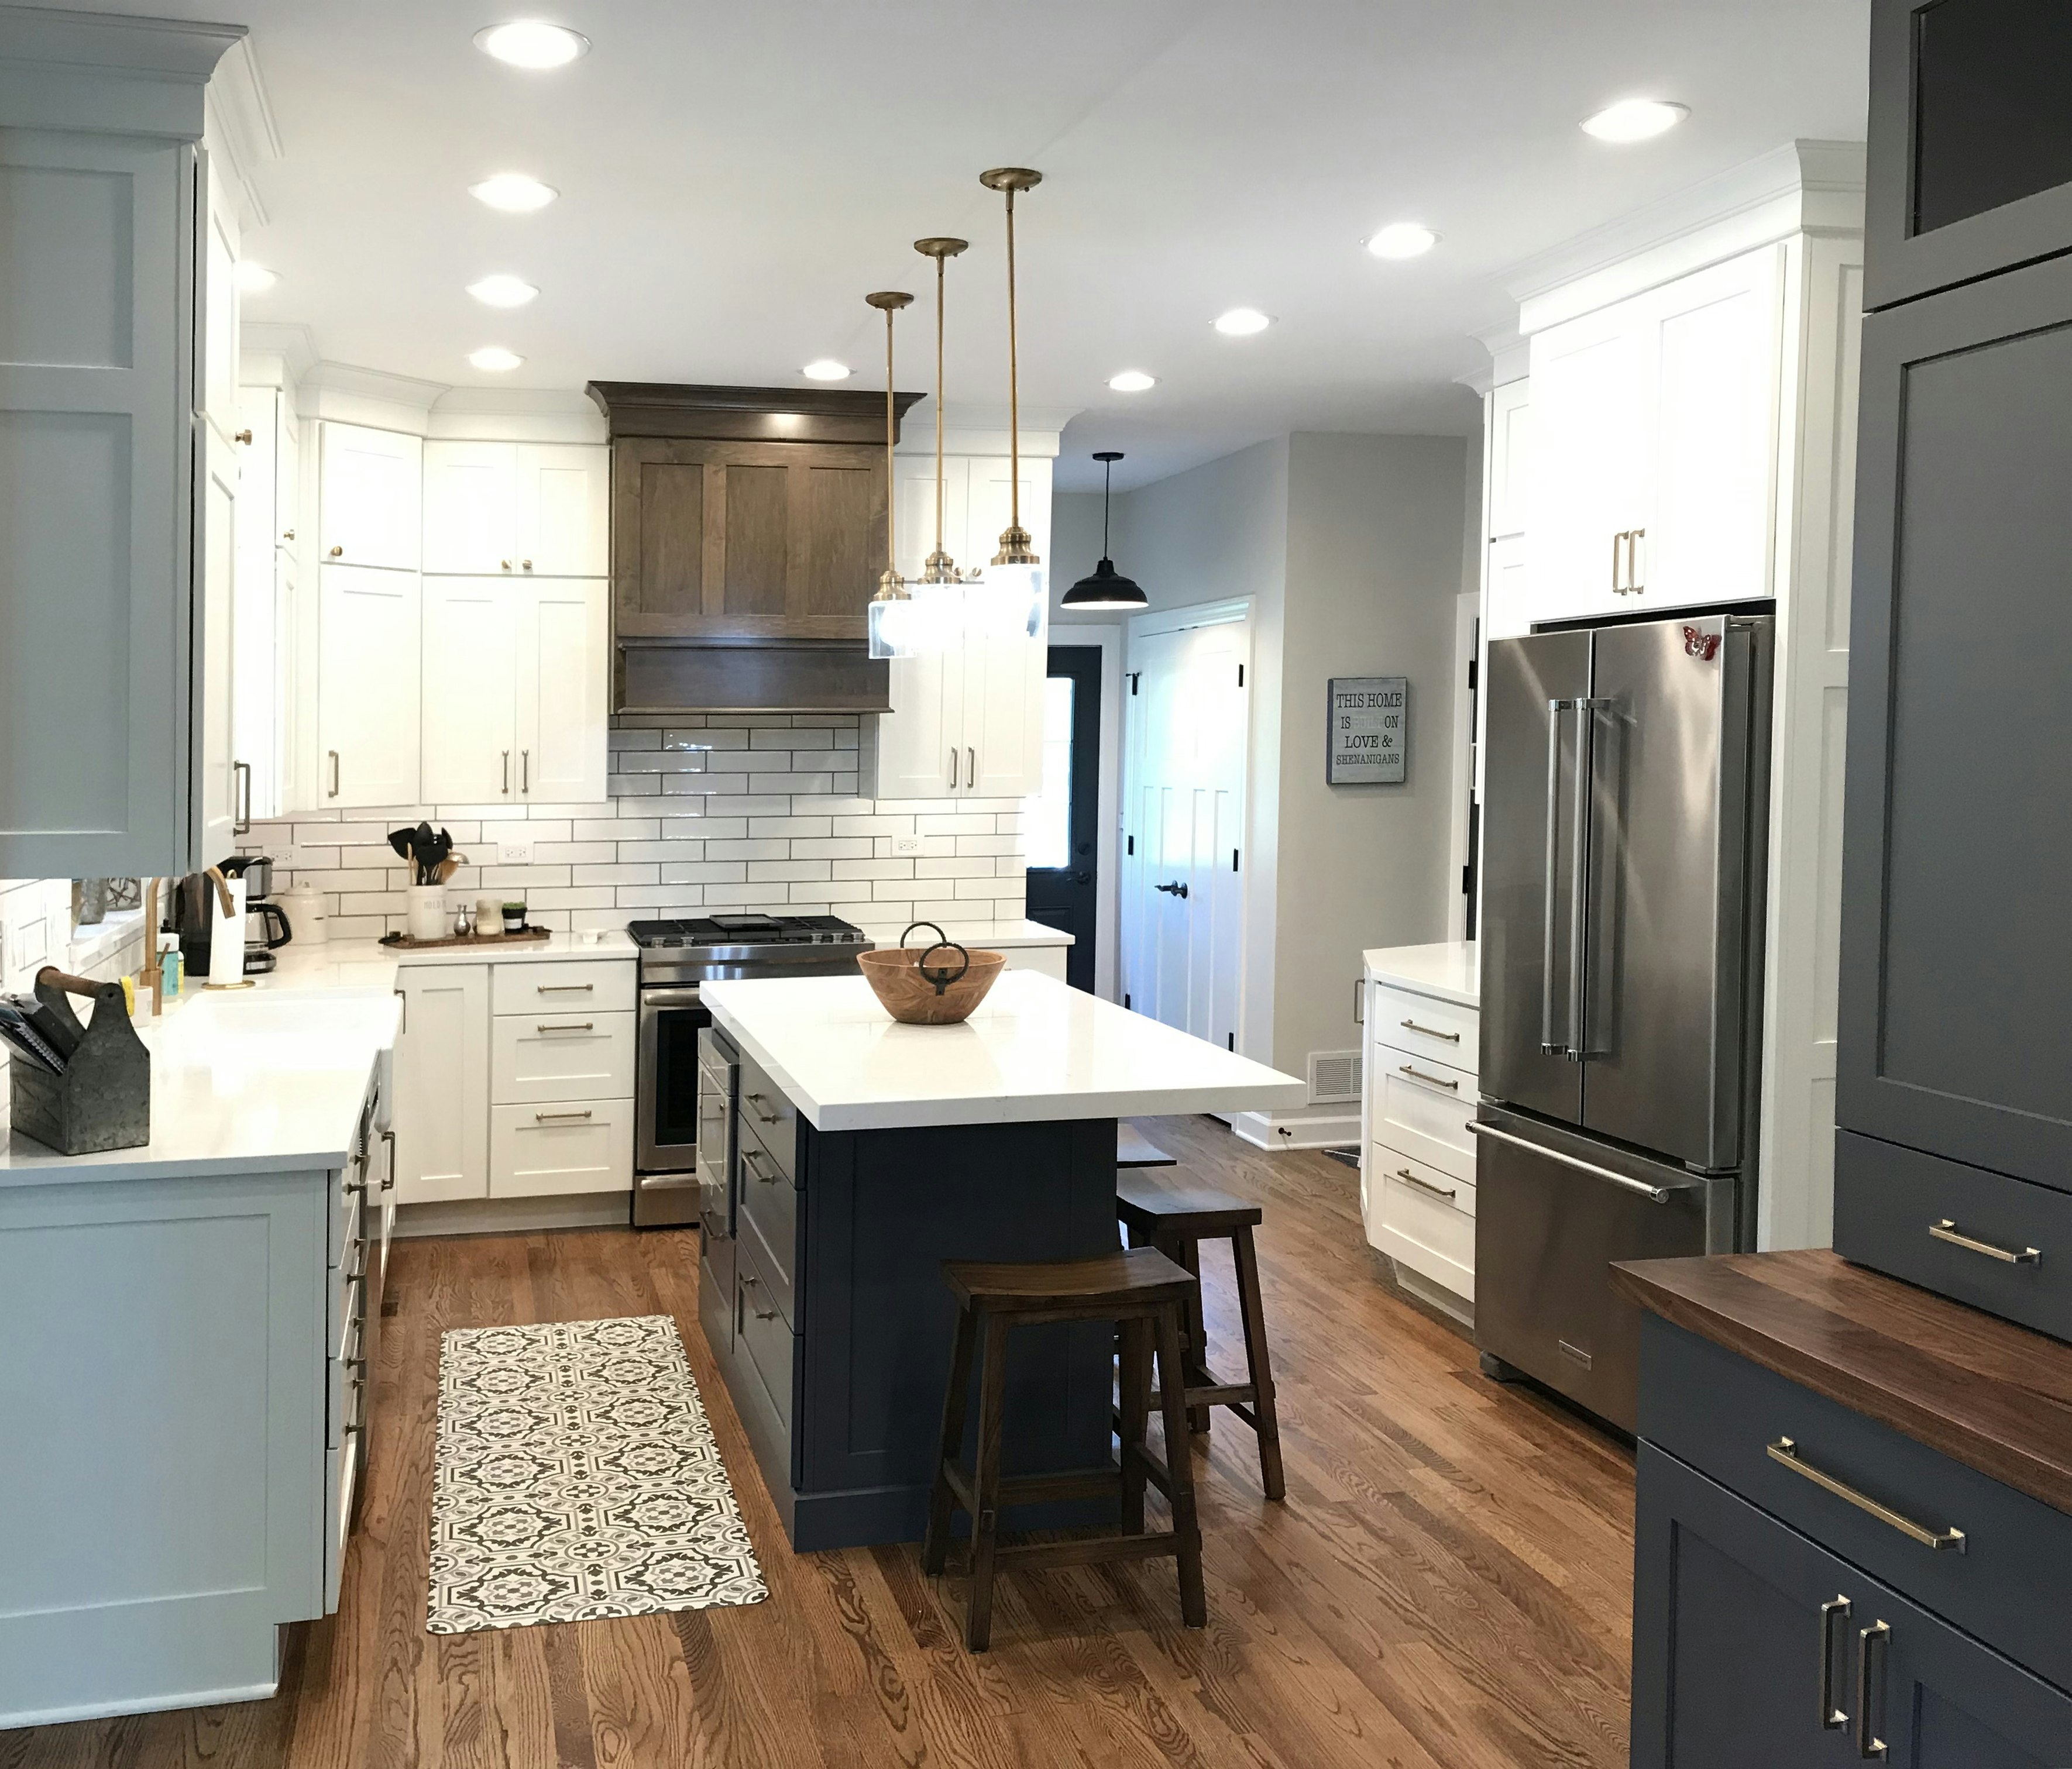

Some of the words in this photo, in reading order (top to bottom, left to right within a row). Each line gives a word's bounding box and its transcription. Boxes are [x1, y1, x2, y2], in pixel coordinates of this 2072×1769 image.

[1336, 693, 1364, 708] THIS
[1367, 693, 1402, 707] HOME
[1341, 717, 1350, 729] IS
[1384, 715, 1398, 728] ON
[1345, 735, 1379, 748] LOVE
[1382, 735, 1393, 747] &
[1336, 753, 1400, 765] SHENANIGANS
